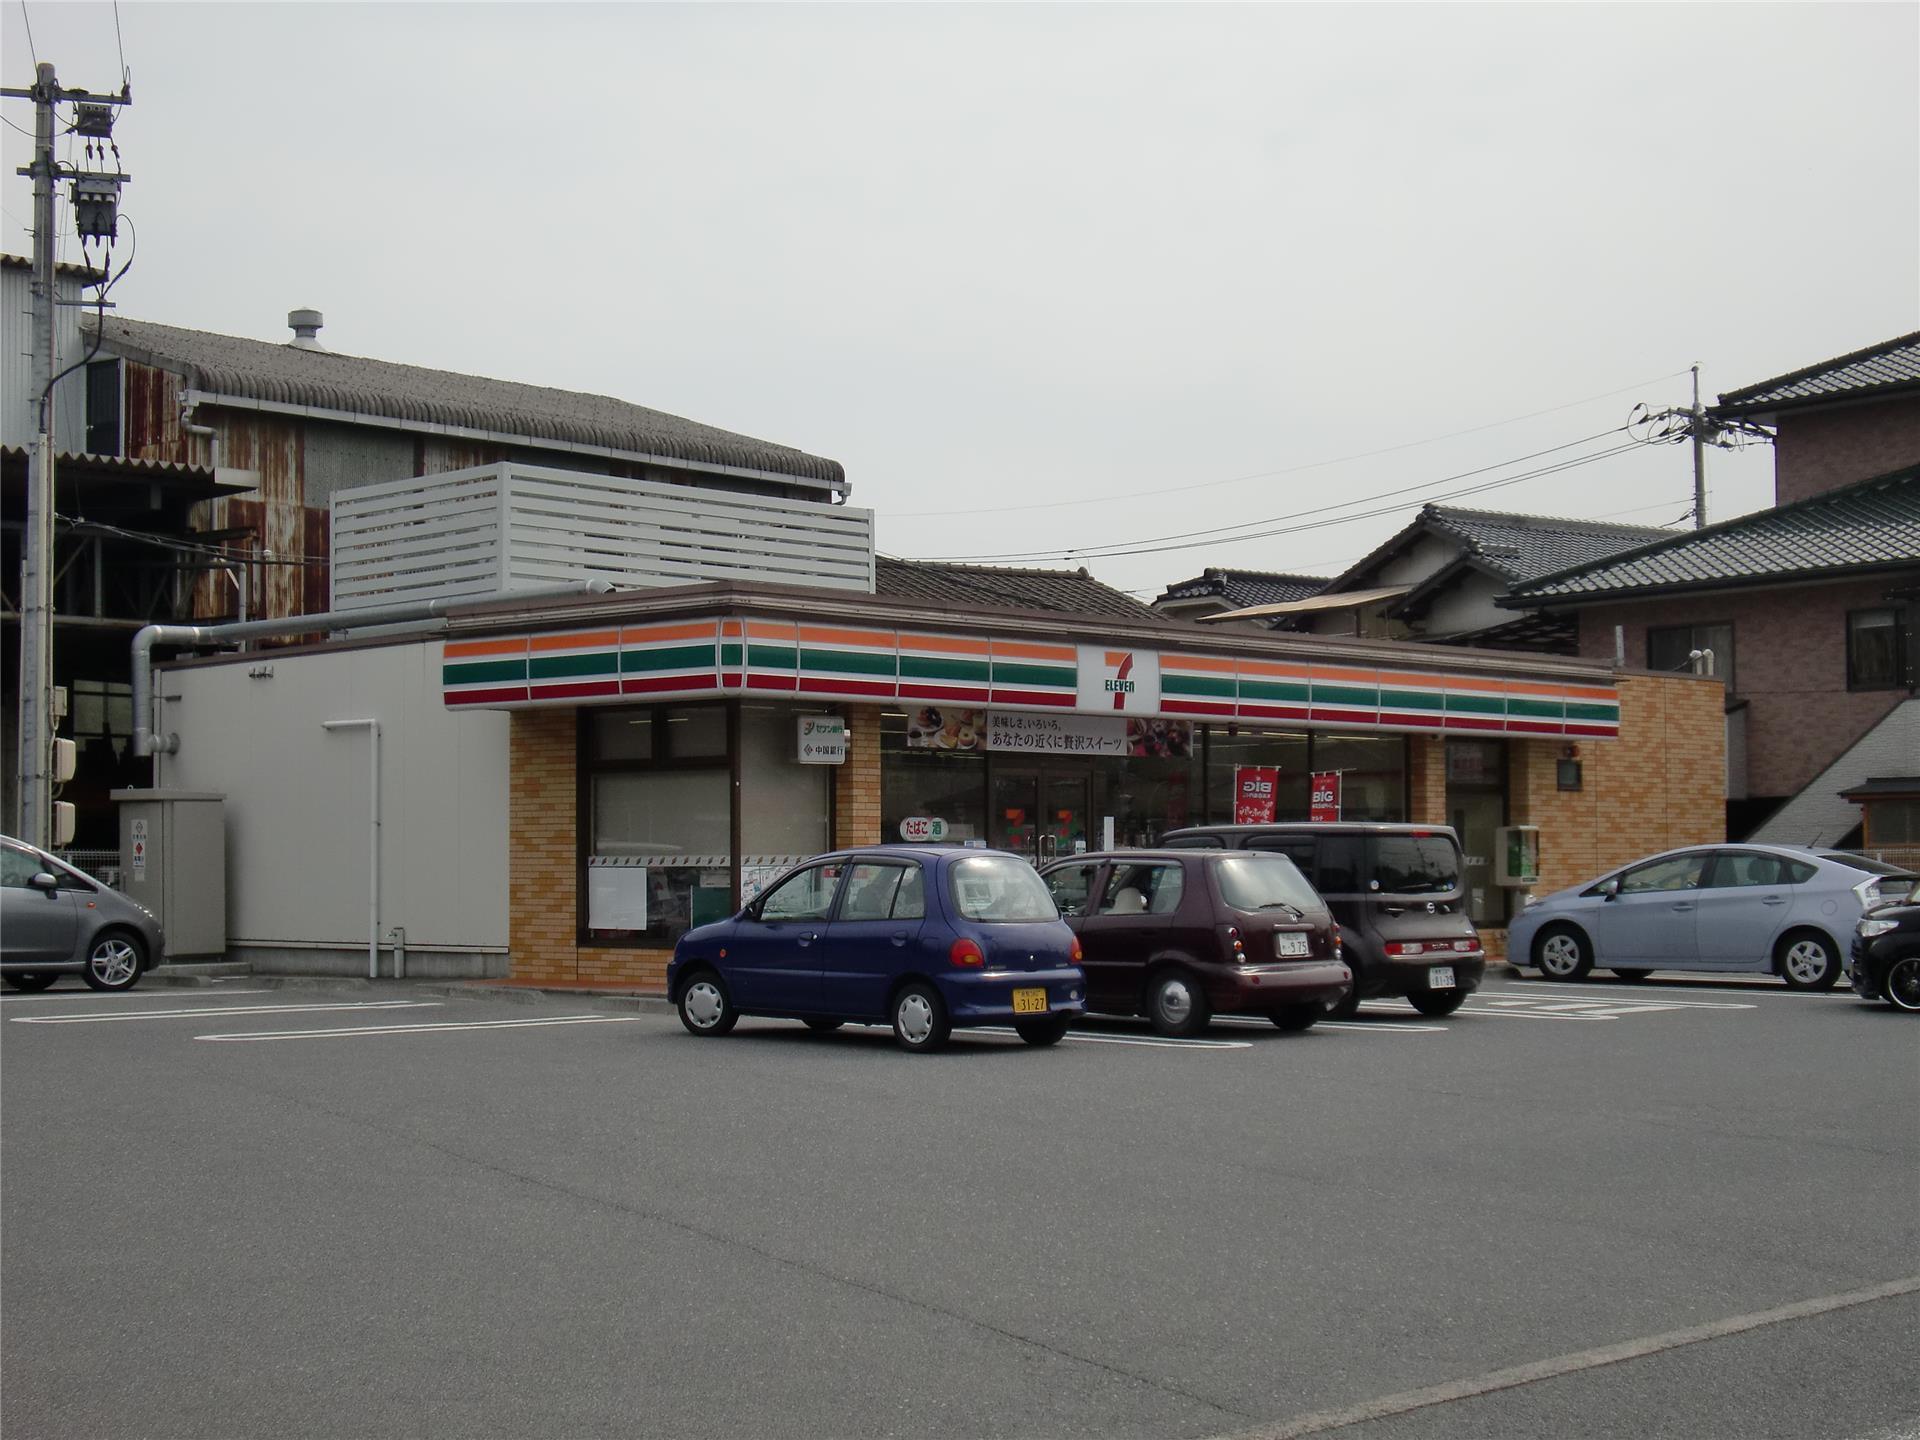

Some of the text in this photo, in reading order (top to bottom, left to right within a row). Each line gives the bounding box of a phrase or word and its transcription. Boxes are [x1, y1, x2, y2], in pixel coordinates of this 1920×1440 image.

[1104, 652, 1133, 710] 7
[992, 731, 1122, 751] あなたの近くに贅沢スイーツ
[815, 745, 843, 756] 中国銀行
[1312, 791, 1334, 802] BIG
[906, 821, 942, 834] たばこ 酒
[1020, 998, 1045, 1011] 31-27
